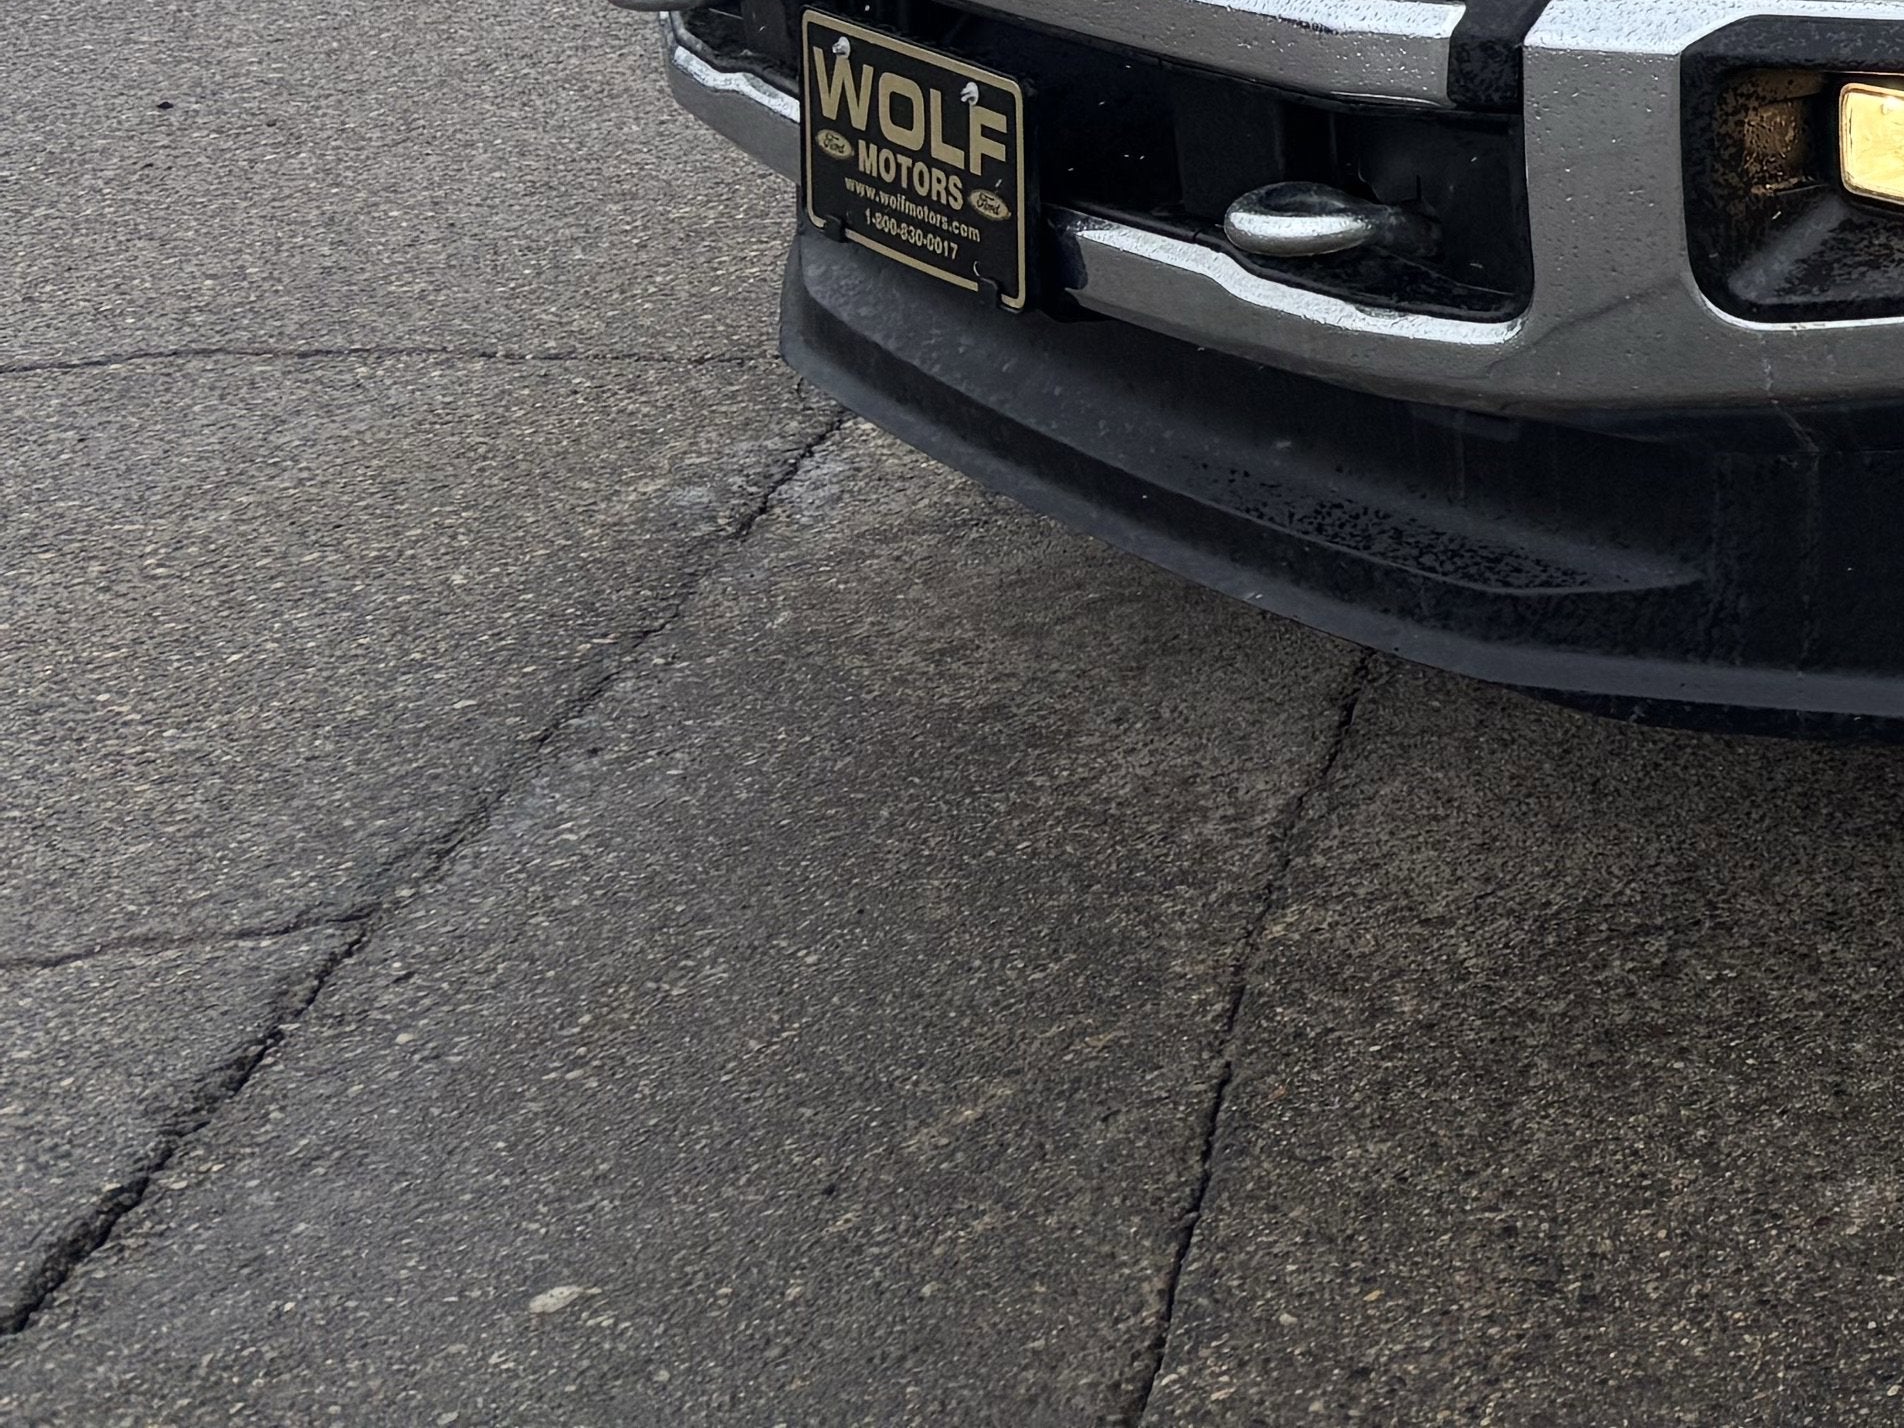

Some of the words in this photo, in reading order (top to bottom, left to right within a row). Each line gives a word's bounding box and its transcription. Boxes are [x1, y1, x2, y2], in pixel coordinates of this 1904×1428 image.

[812, 46, 1007, 176] WOLF
[845, 176, 981, 243] www.wolfmotors.com
[858, 139, 964, 211] MOTORS
[865, 208, 959, 260] 1-800-830-0017
